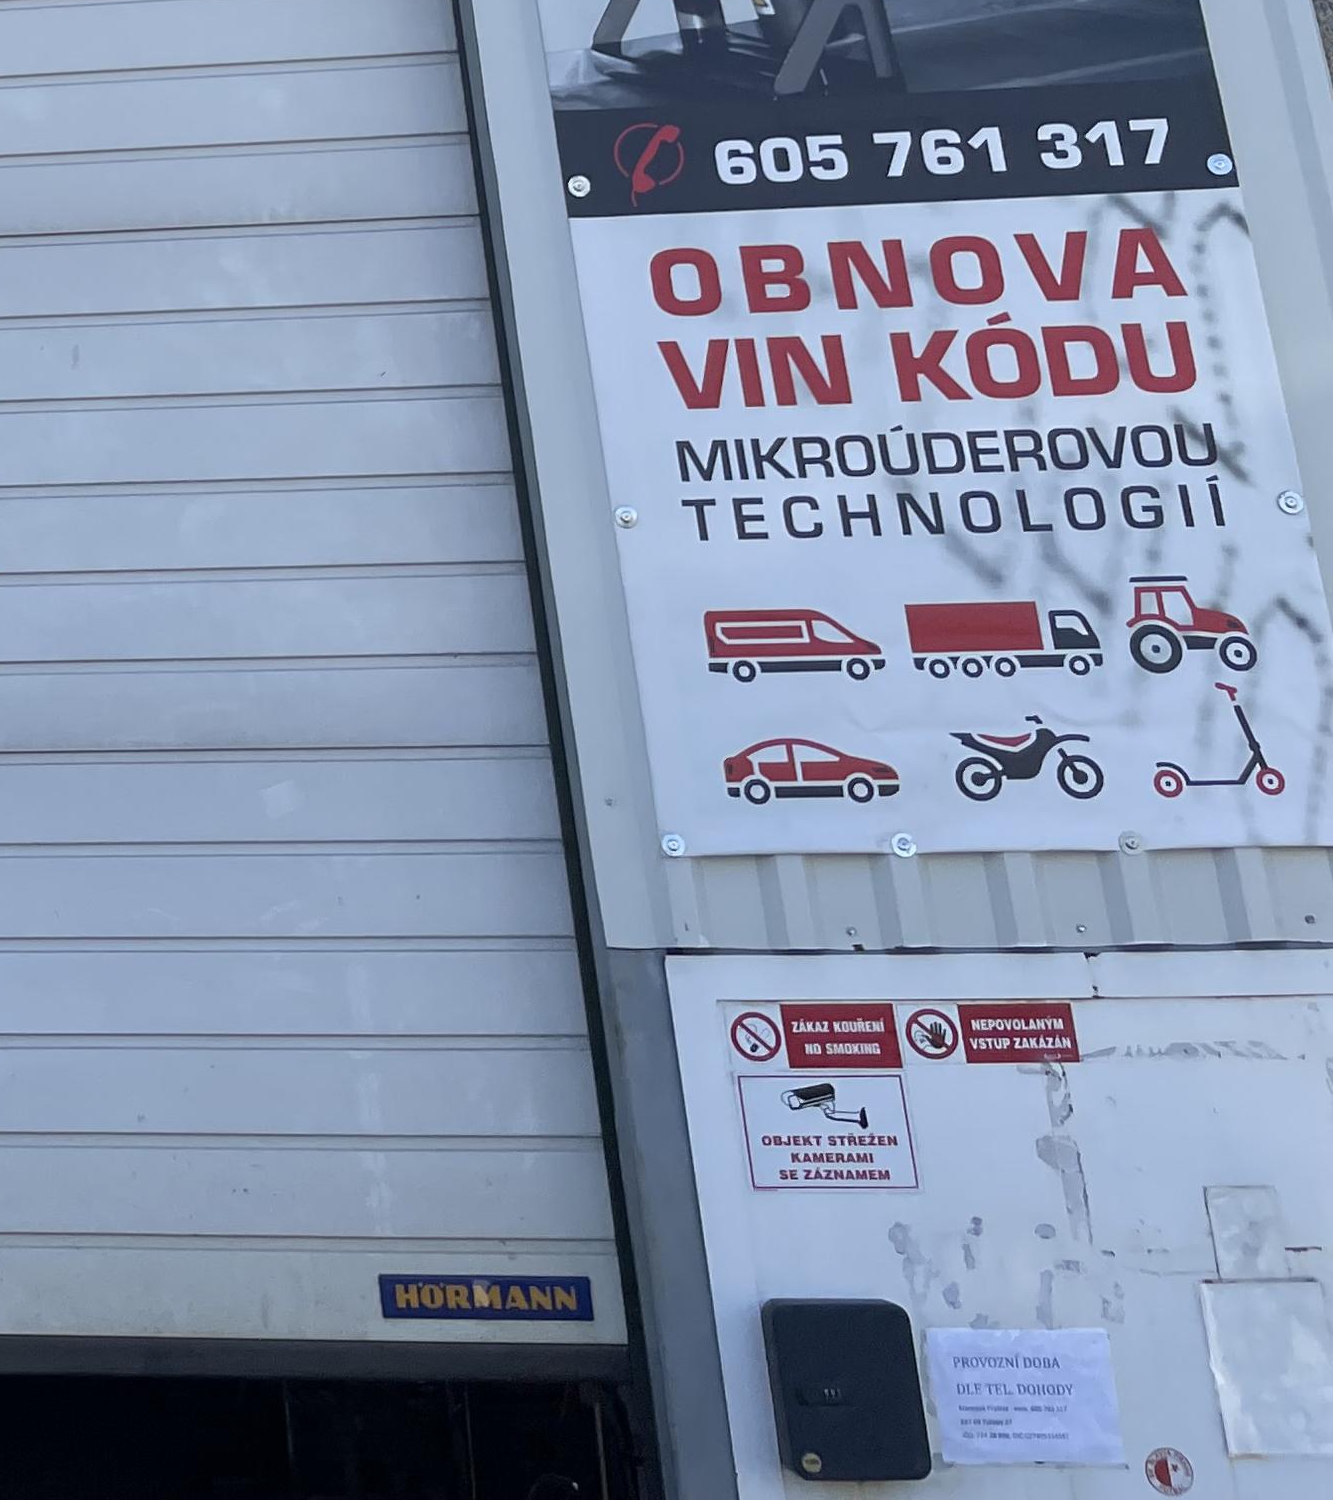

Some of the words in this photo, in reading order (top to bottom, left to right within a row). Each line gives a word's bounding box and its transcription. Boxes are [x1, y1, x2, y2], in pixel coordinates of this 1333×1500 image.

[714, 135, 849, 185] 605
[873, 127, 1007, 178] 761
[1037, 118, 1170, 170] 317
[649, 228, 1189, 317] OBNOVA
[657, 334, 853, 410] VIN
[889, 311, 1199, 403] KÓDU
[675, 422, 1219, 482] MIKROÚDEROVOU
[682, 475, 1227, 541] TECHNOLOGIÍ
[791, 1018, 829, 1033] ZÁKAZ
[833, 1017, 885, 1033] KOUŘENÍ
[970, 1016, 1066, 1032] NEPOVOLANÝM
[804, 1043, 821, 1055] NO
[826, 1042, 882, 1055] SMOKING
[969, 1037, 1011, 1050] VSTUP
[1013, 1035, 1072, 1050] ZAKÁZÁN
[761, 1135, 823, 1147] OBJEKT
[827, 1132, 899, 1147] STŘEŽEN
[790, 1152, 875, 1164] KAMERAMI
[779, 1169, 800, 1181] SE
[804, 1167, 892, 1181] ZÁZNAMEM
[952, 1353, 1020, 1370] PROVOZNÍ
[1023, 1356, 1062, 1370] DOBA
[956, 1382, 982, 1396] DLE
[1017, 1383, 1074, 1397] DOHODY
